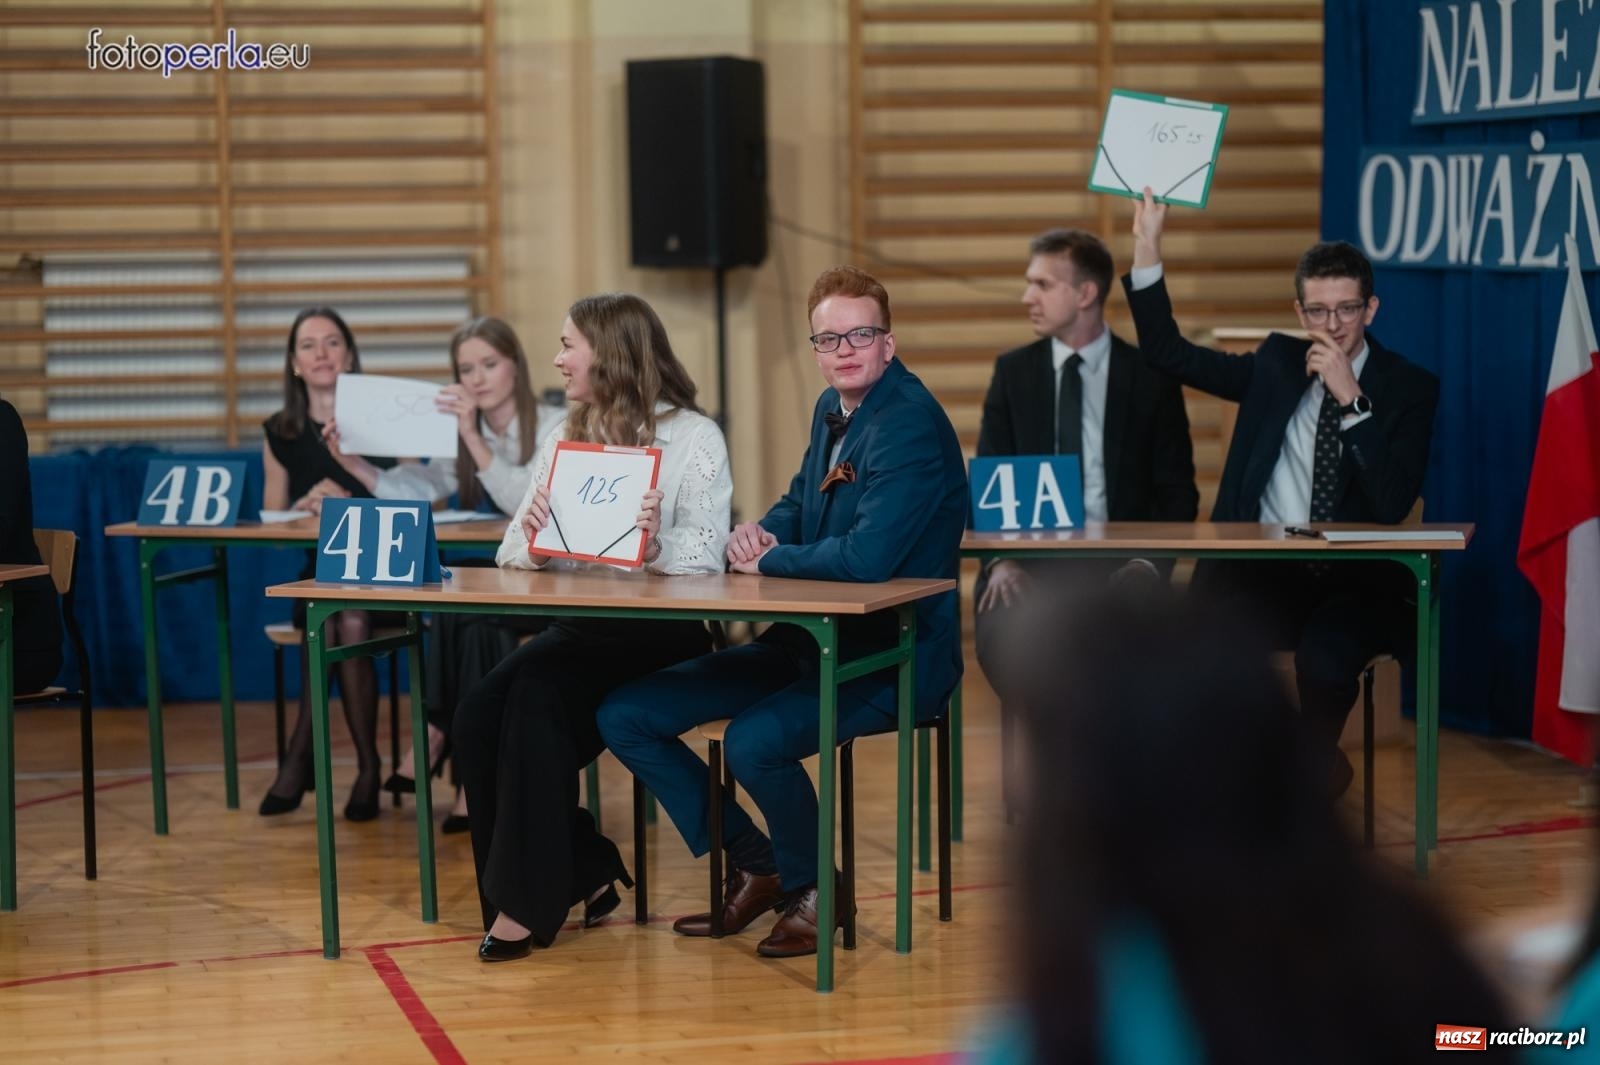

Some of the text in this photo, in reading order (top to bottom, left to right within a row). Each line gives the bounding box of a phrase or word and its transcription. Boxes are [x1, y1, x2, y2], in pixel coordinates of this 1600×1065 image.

[1413, 0, 1600, 117] NALE
[1146, 121, 1188, 143] 165
[146, 465, 231, 526] 4B
[577, 474, 631, 505] 125
[323, 506, 419, 583] 4E
